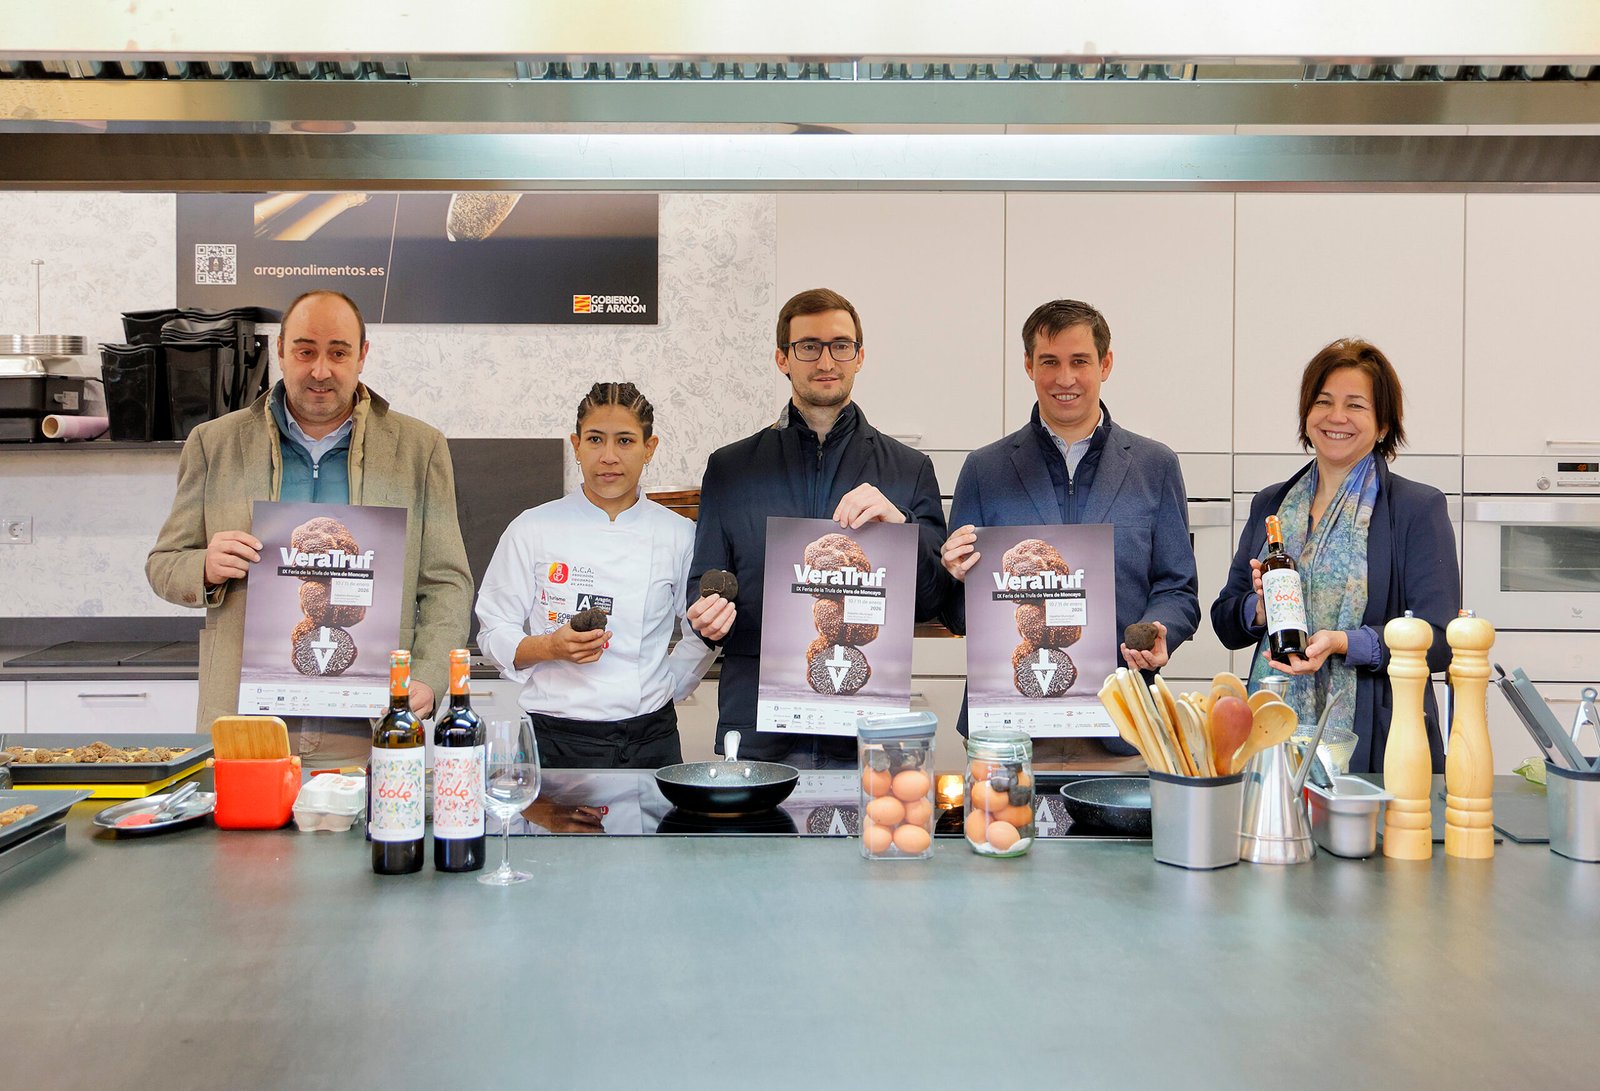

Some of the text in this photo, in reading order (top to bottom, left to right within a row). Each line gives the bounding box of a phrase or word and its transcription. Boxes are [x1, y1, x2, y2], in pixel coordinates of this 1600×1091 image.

[254, 264, 385, 278] aragonalimentos.es
[591, 295, 640, 304] GOBIERNO
[591, 304, 646, 313] DE ARAGON
[280, 547, 375, 569] VeraTruf
[572, 566, 594, 574] A.C.A.
[794, 564, 886, 587] VeraTruf
[992, 568, 1085, 590] VeraTruf
